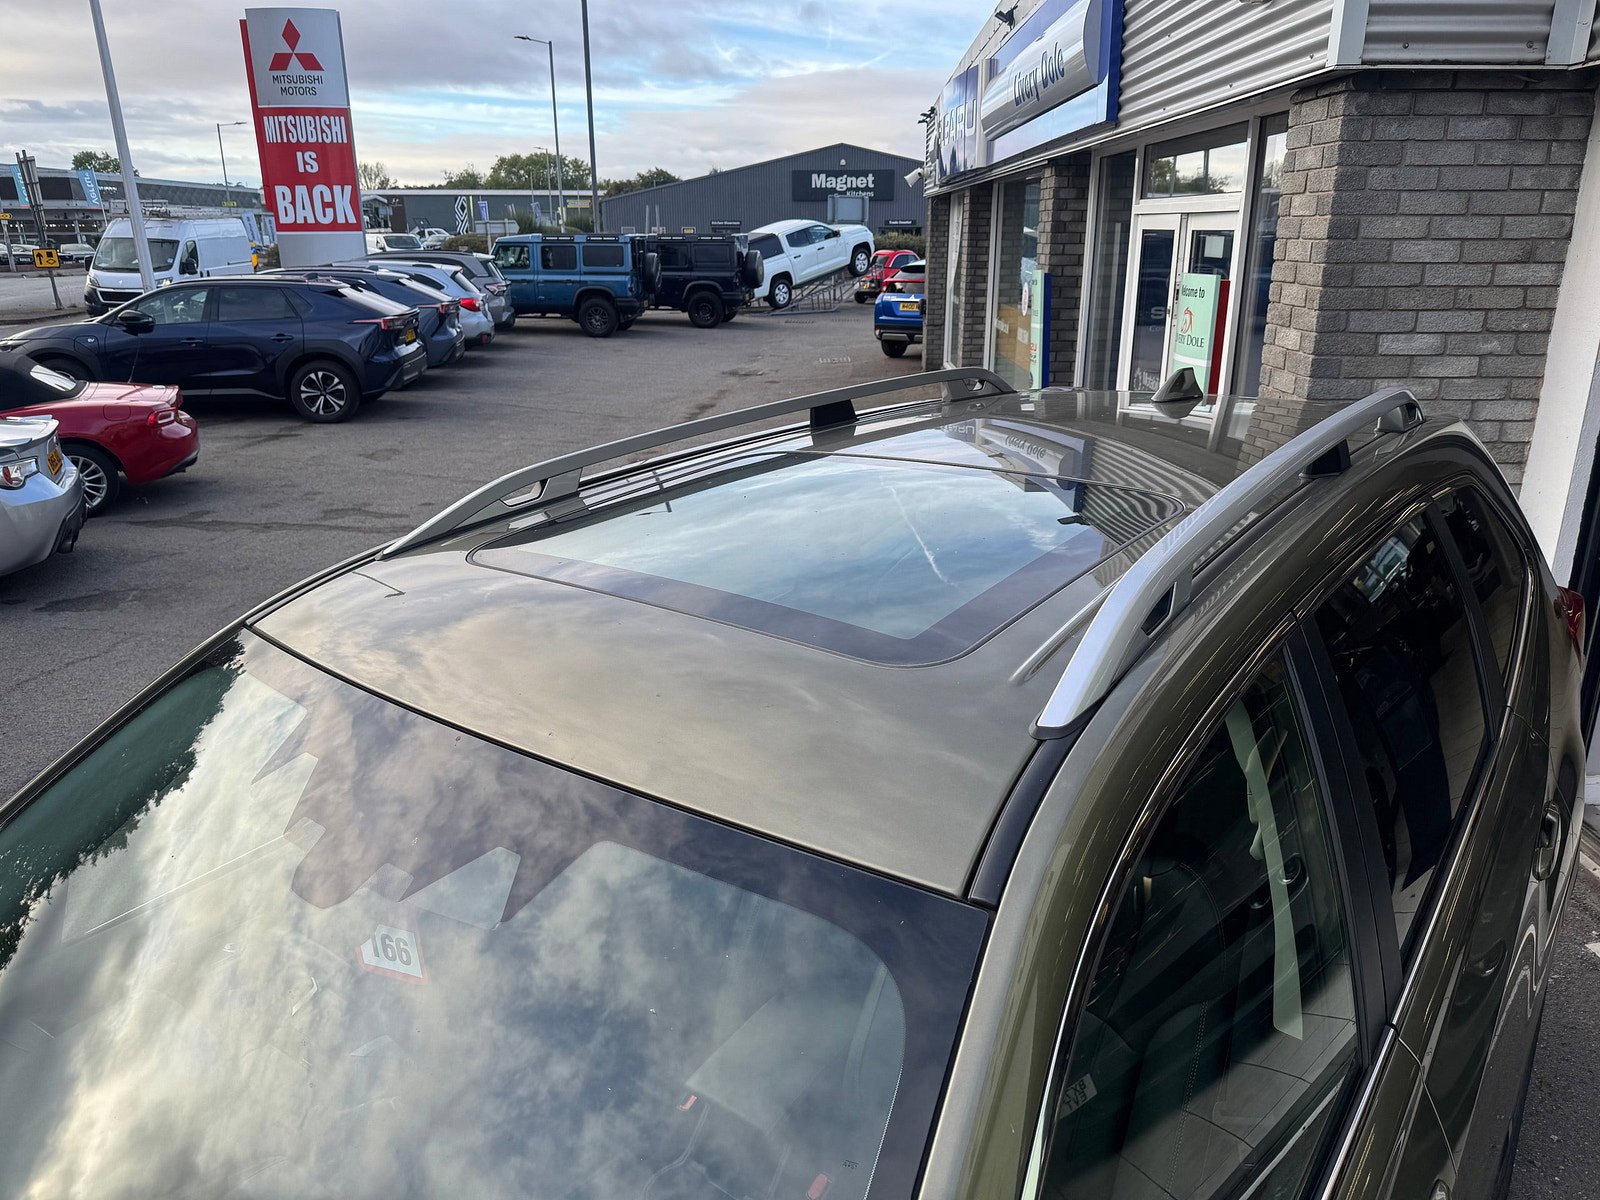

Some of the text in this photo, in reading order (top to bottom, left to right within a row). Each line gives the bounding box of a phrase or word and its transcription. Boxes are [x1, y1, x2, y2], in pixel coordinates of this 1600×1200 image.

[272, 75, 323, 85] MITSUBISHI
[1014, 41, 1065, 106] Livery Dole
[280, 86, 317, 96] MOTORS
[263, 115, 348, 144] MITSUBISHI
[296, 151, 319, 174] IS
[811, 173, 875, 191] Magnet
[275, 184, 357, 225] BACK
[1186, 334, 1205, 348] DOLE
